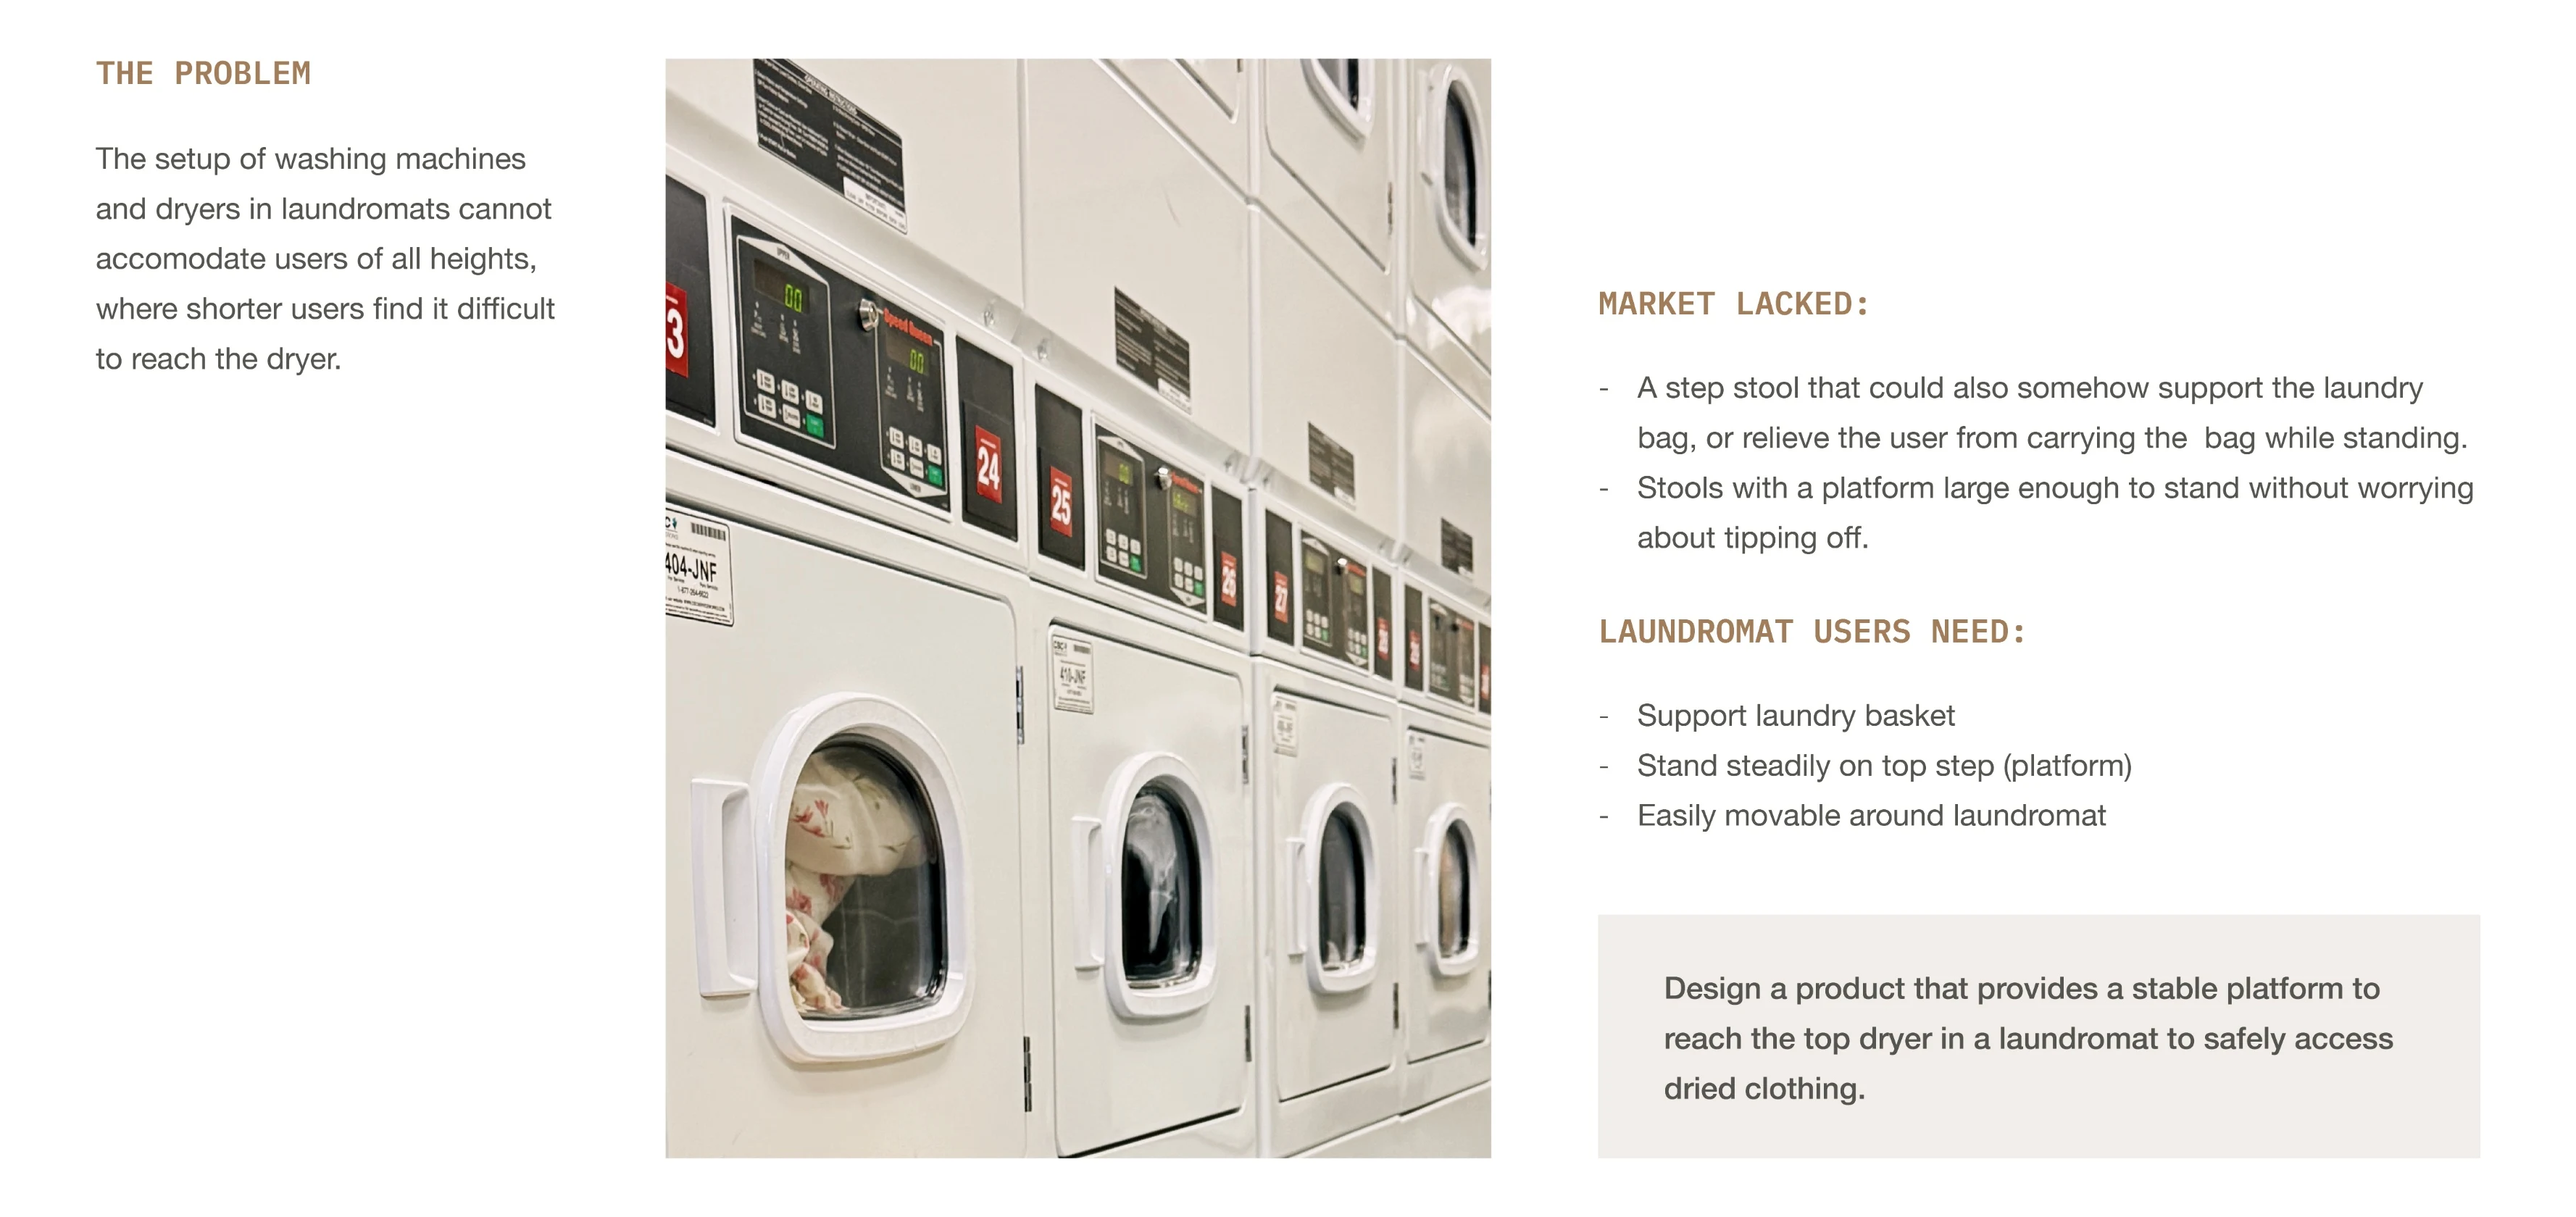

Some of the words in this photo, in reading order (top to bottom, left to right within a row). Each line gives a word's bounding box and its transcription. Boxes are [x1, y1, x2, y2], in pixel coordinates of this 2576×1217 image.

[777, 247, 790, 261] UPPER
[667, 308, 684, 359] 3
[978, 446, 1000, 490] 24
[1052, 485, 1071, 526] 25
[665, 551, 717, 582] 404-JNF
[1222, 565, 1236, 598] 26
[1275, 584, 1288, 613] 27
